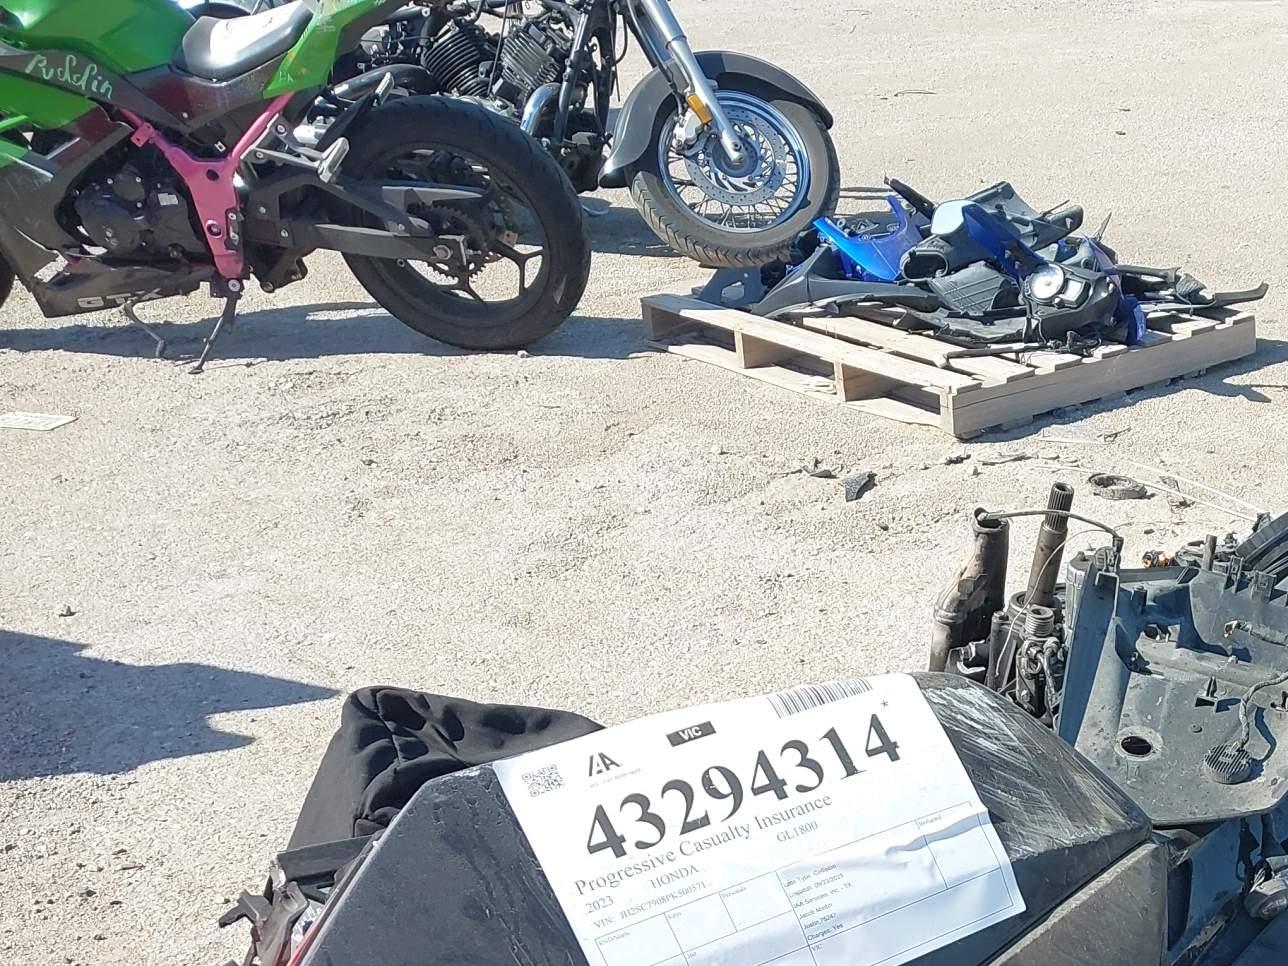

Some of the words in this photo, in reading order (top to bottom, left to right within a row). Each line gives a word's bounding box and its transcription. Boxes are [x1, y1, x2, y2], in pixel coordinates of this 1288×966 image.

[679, 726, 702, 740] VIC
[587, 713, 901, 859] 43294314
[776, 820, 819, 843] GL1800
[574, 849, 677, 897] Progressive
[679, 823, 751, 857] Casualty
[754, 794, 833, 831] Insurance
[650, 864, 700, 890] HONDA
[585, 895, 614, 914] 2023
[593, 916, 616, 930] VIN:
[832, 922, 844, 932] Yes
